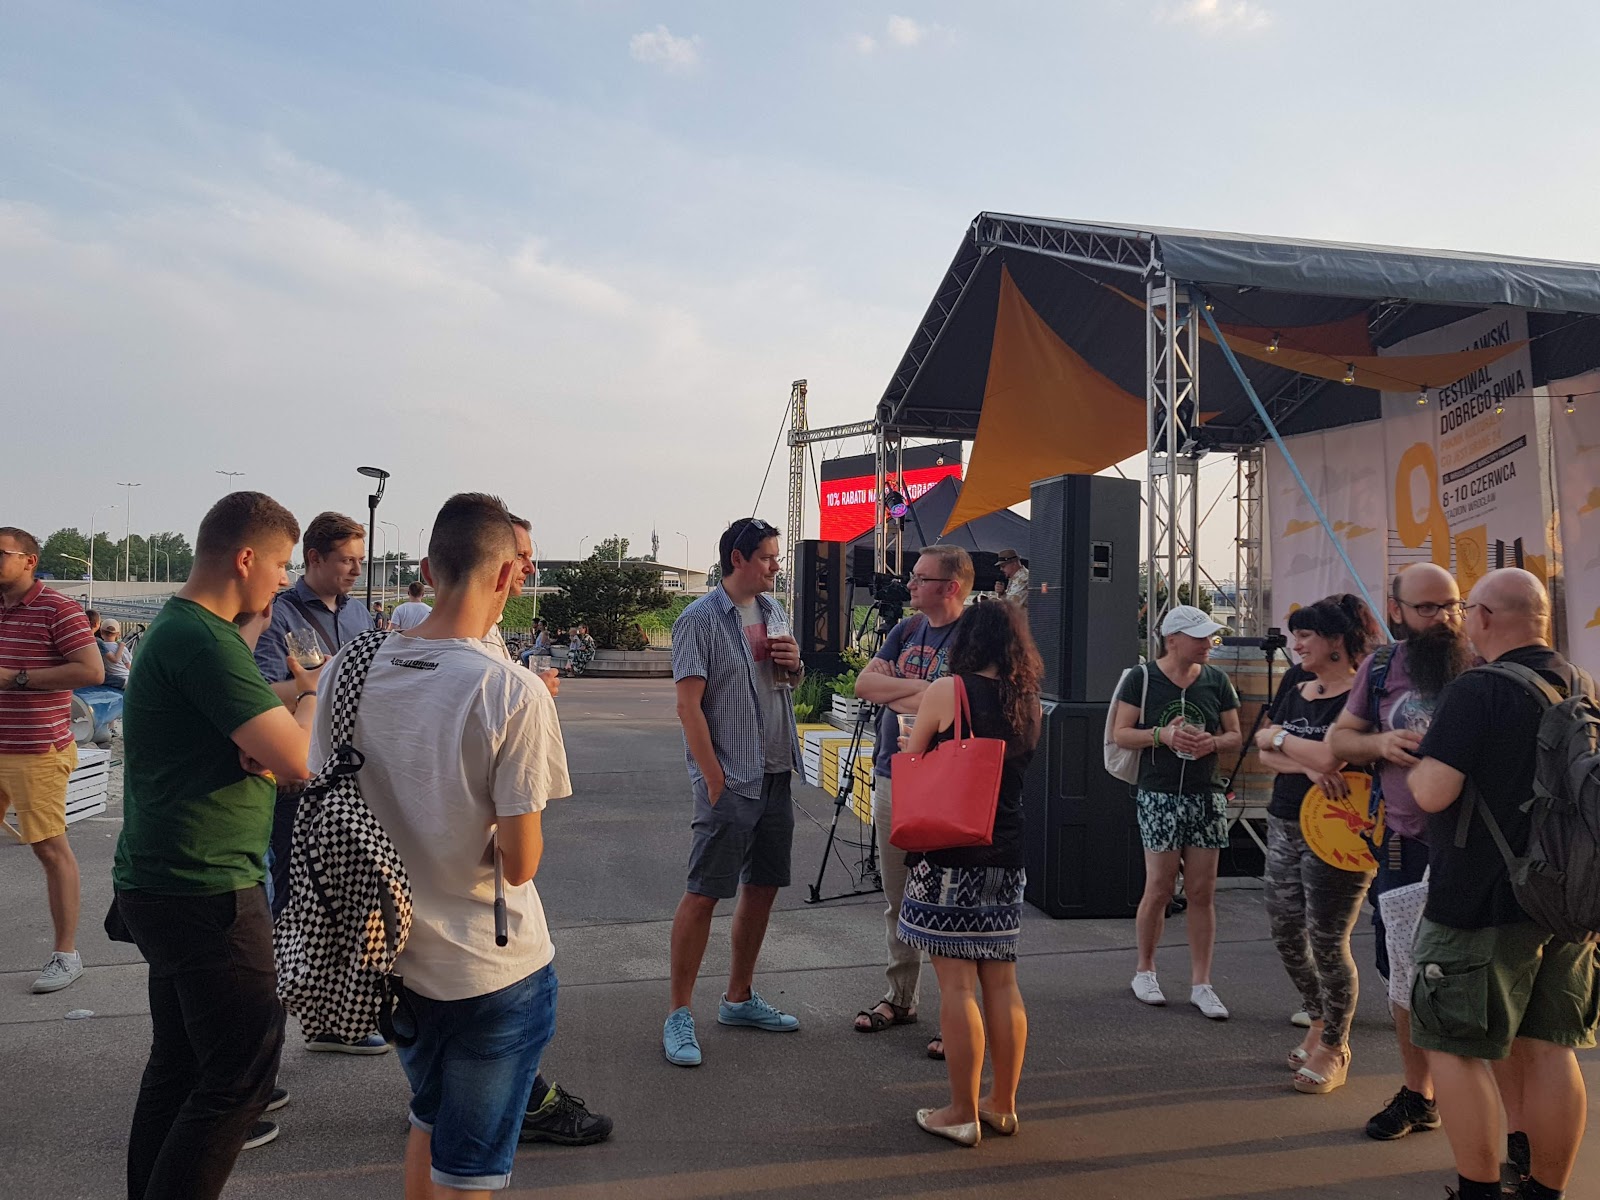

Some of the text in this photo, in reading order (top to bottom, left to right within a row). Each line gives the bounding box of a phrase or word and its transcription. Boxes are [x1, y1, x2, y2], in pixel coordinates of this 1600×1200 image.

[1438, 365, 1492, 411] FESTIWAL
[1440, 369, 1526, 436] DOBREGO PIWA
[826, 492, 841, 507] 10%
[841, 489, 866, 506] RABATU
[1442, 461, 1517, 508] 8-10 CZERWCA
